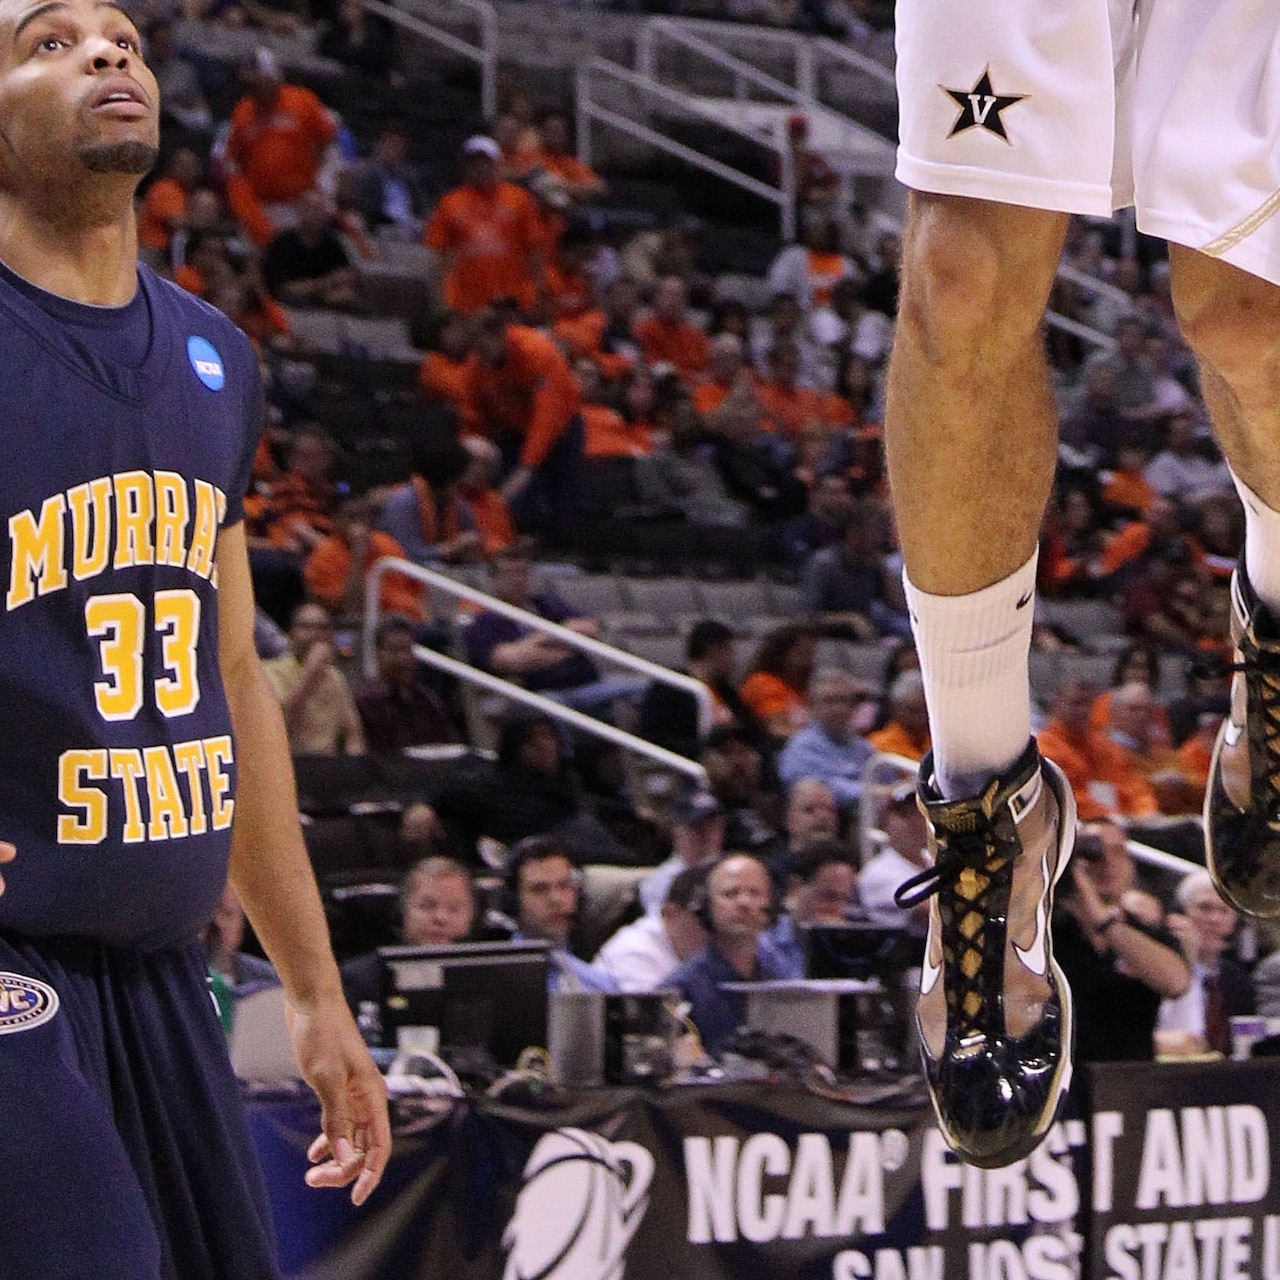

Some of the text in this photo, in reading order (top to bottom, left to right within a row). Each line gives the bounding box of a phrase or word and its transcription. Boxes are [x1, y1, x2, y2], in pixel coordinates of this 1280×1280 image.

[85, 589, 201, 722] 33
[57, 739, 235, 844] STATE
[922, 1111, 1123, 1233] FIRST
[1136, 1104, 1270, 1210] AND
[1105, 1216, 1254, 1280] STATE
